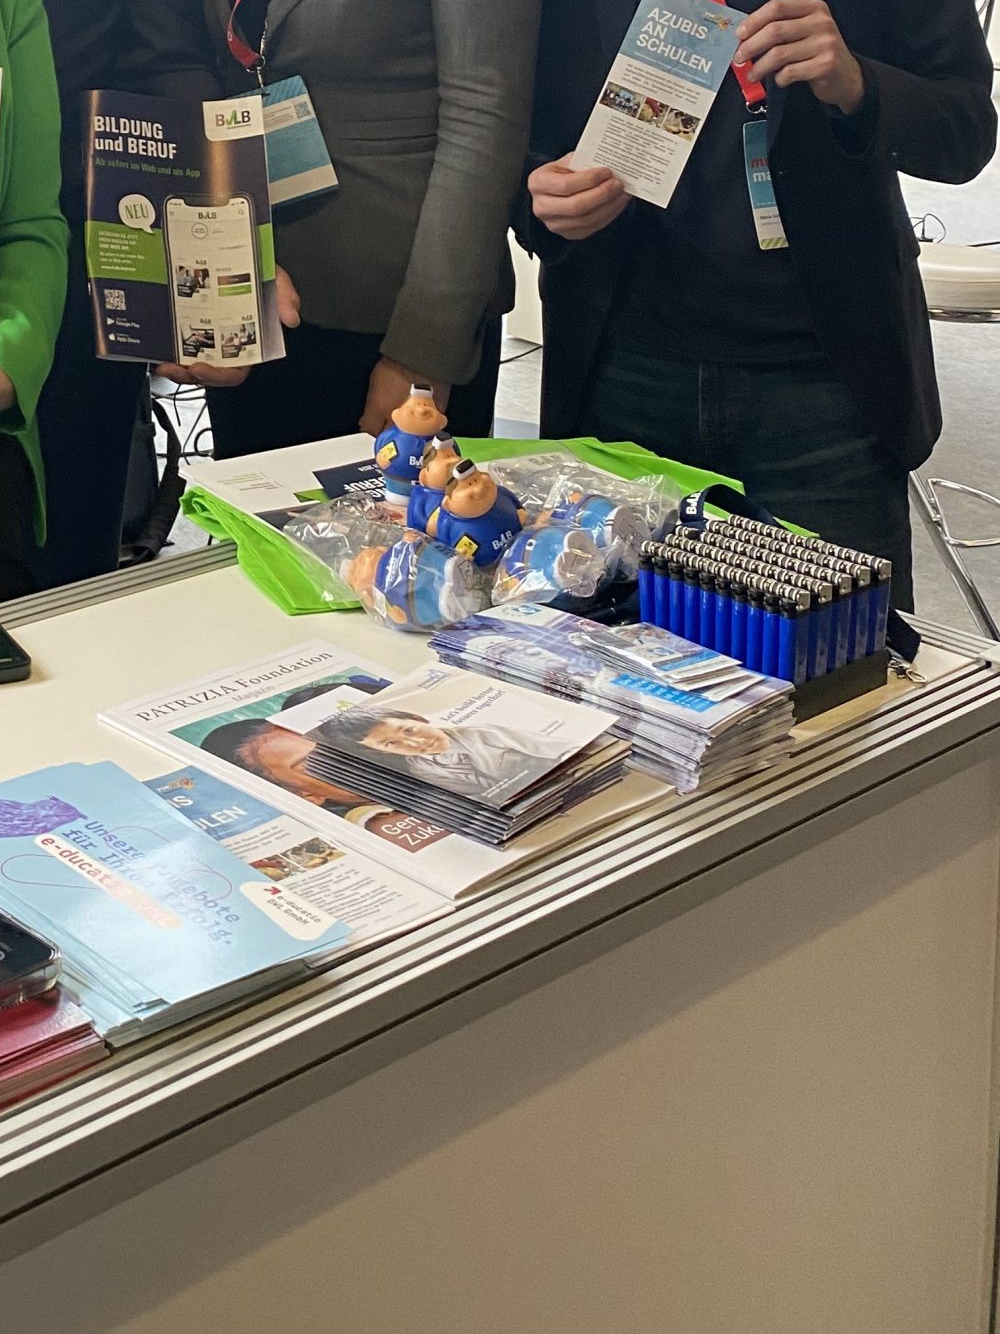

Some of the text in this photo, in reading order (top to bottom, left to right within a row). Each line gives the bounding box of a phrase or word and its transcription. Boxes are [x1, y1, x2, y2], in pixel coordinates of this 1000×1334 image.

[641, 21, 668, 39] AN
[648, 7, 708, 39] AZUBIS
[636, 34, 712, 74] SCHULEN
[94, 116, 163, 138] BILDUNG
[95, 137, 177, 159] und BERUF
[141, 162, 157, 173] Web
[185, 168, 200, 179] App
[125, 203, 149, 219] NEU
[137, 651, 333, 722] PATRIZIA Foundation
[232, 684, 277, 702] Magazin
[62, 828, 98, 851] für
[84, 820, 146, 861] Unsere
[277, 895, 322, 923] e-ducatio
